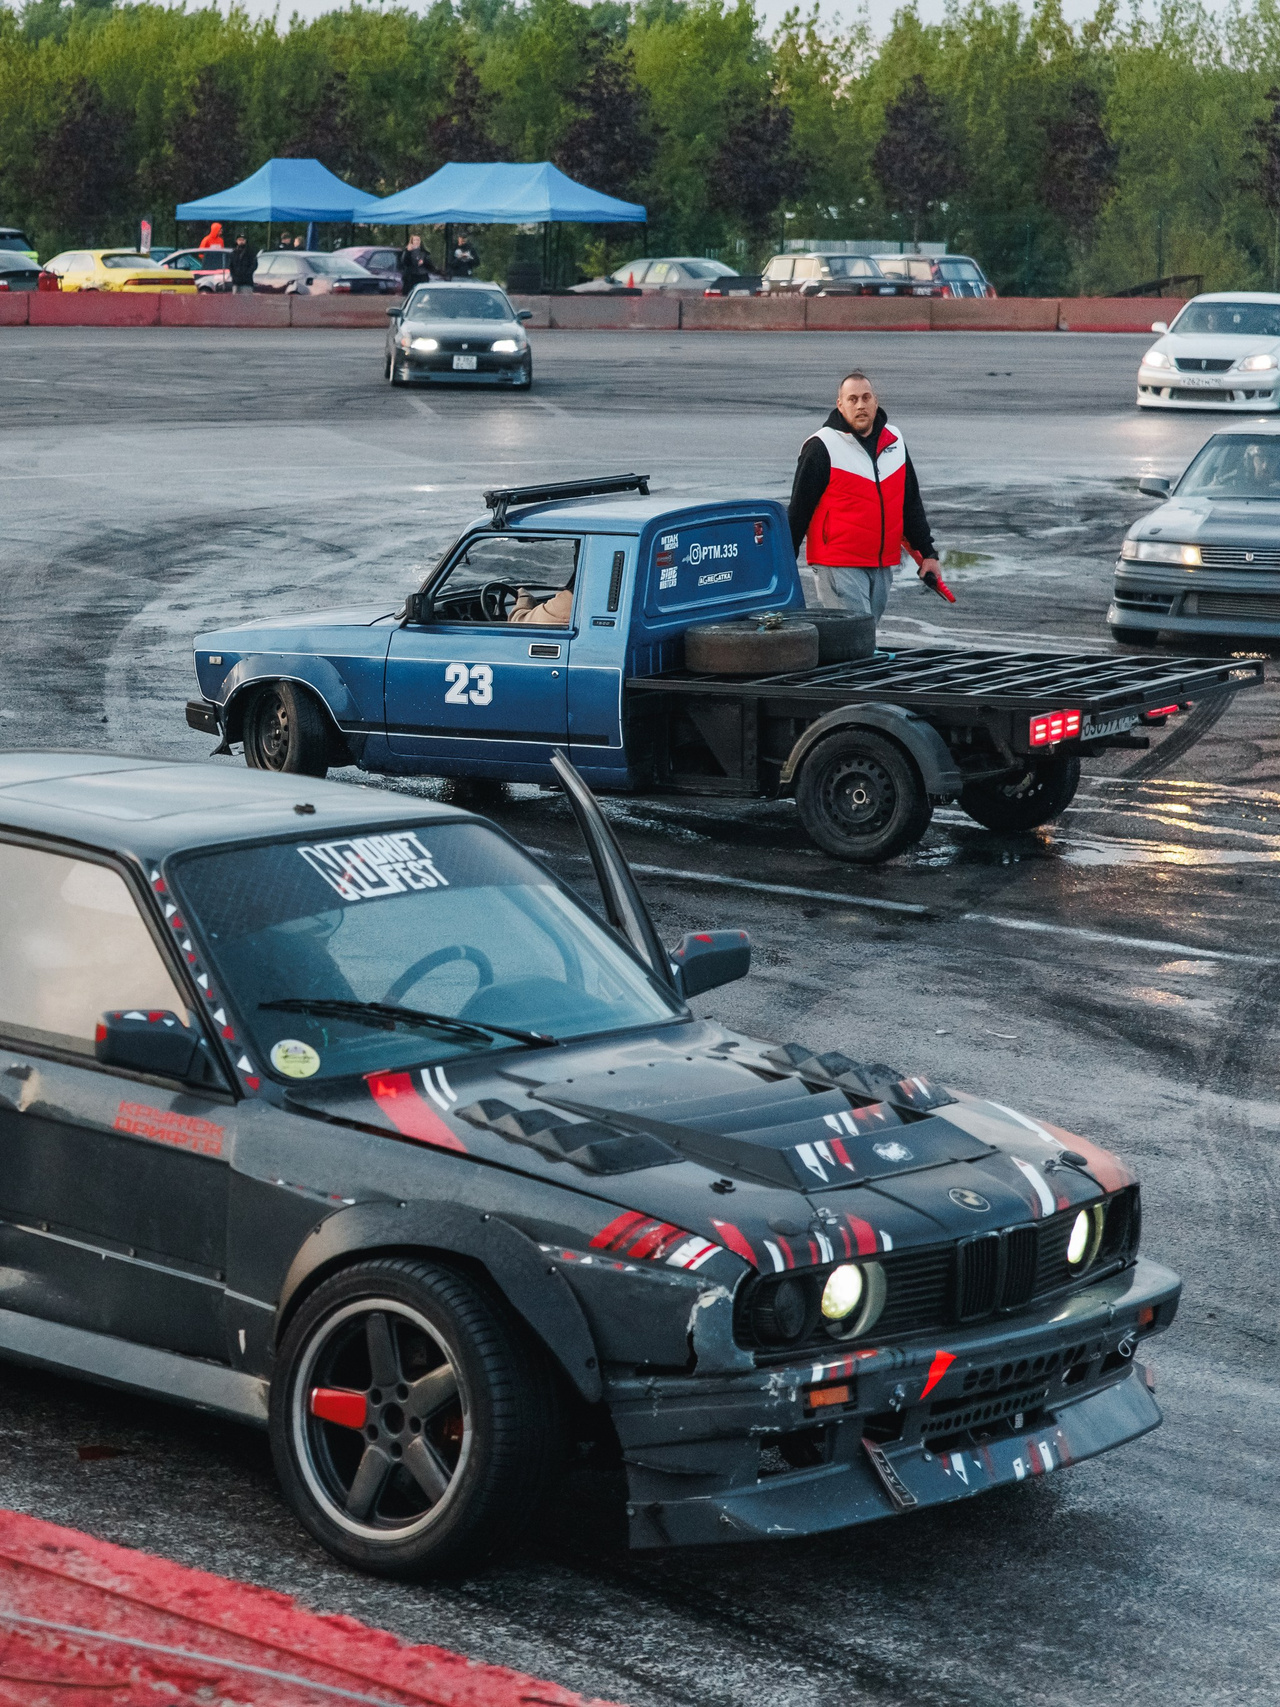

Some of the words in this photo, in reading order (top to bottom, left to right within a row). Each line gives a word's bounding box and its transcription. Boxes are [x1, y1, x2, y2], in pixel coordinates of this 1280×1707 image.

[701, 543, 738, 560] PTM.335
[444, 662, 494, 706] 23
[352, 831, 433, 865] DRIFT
[377, 858, 450, 892] FEST
